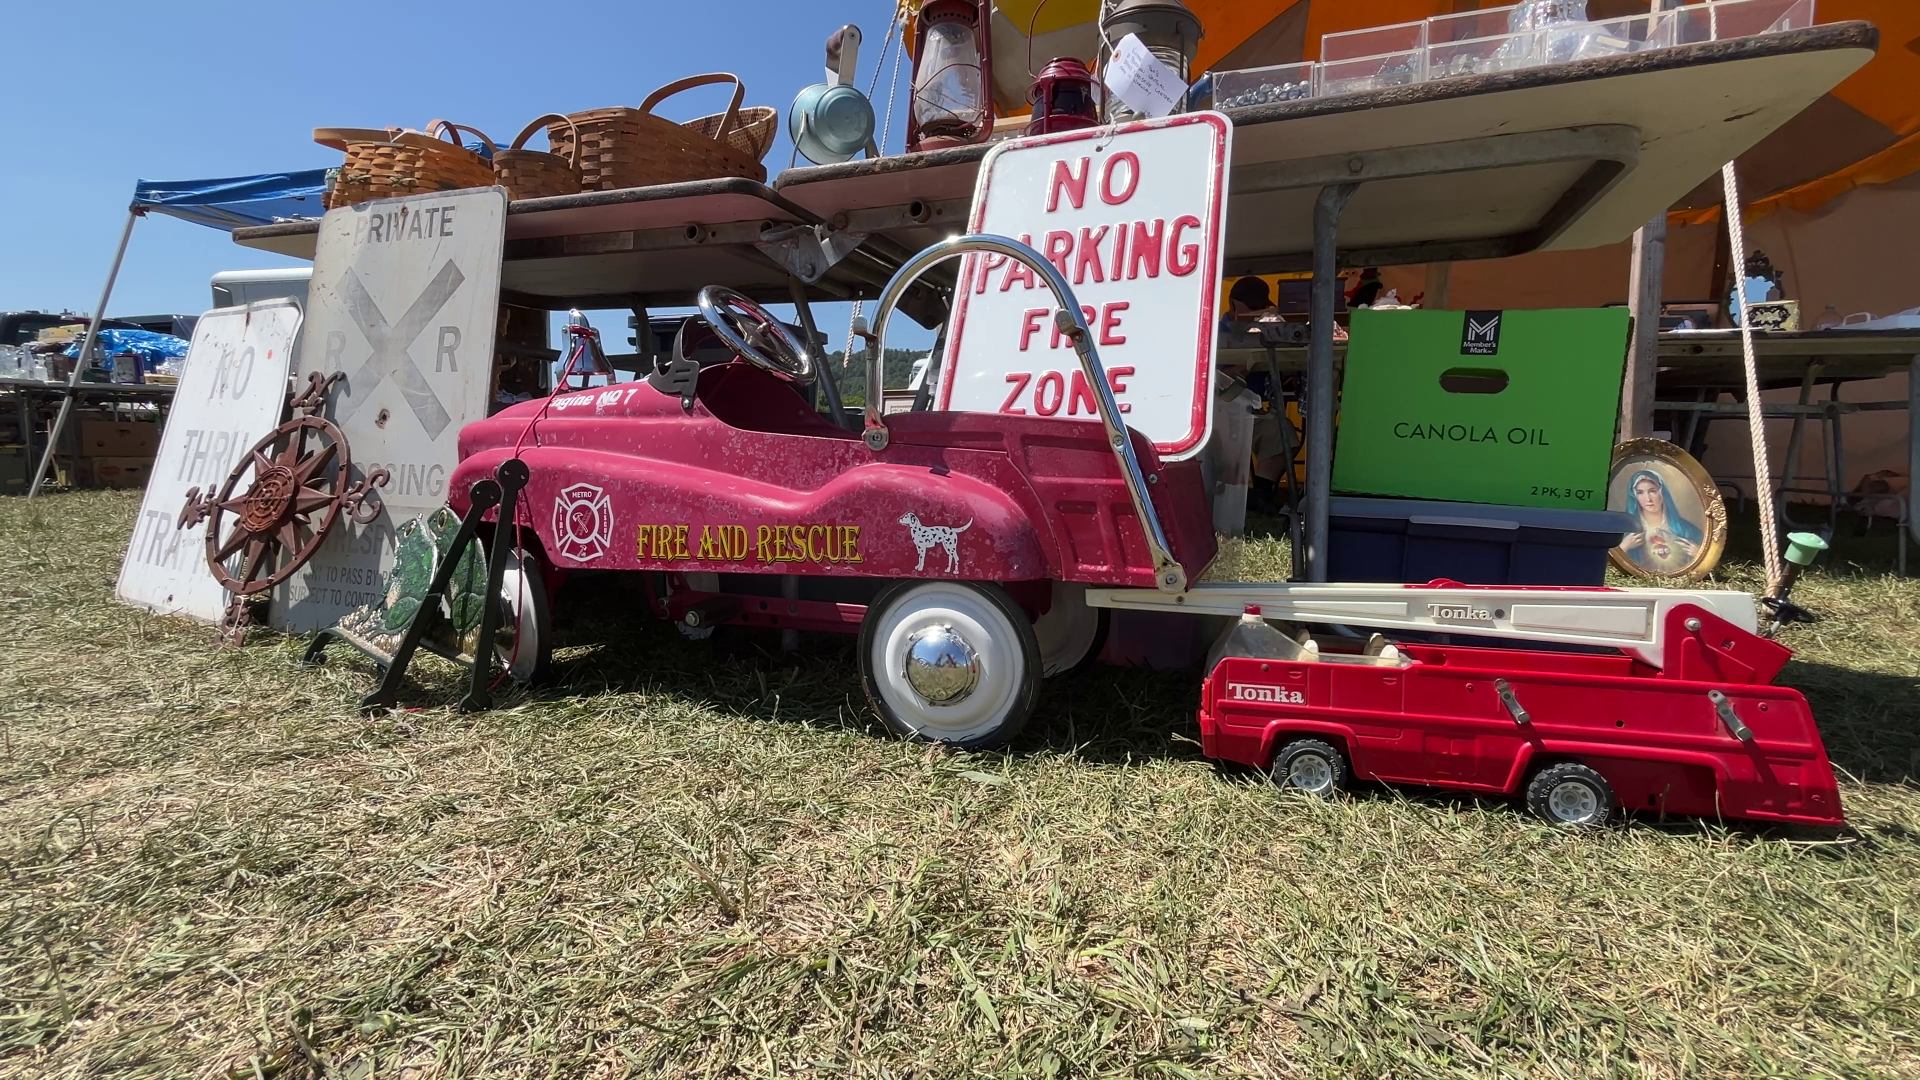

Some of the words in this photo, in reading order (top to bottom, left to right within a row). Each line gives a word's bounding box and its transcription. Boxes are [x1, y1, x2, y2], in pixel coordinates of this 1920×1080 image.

[1044, 151, 1140, 214] NO
[354, 205, 456, 247] PRIVATE
[975, 215, 1201, 295] PARKING
[435, 325, 462, 373] R
[208, 345, 256, 400] NO
[623, 388, 639, 406] 7
[1000, 366, 1136, 416] ZONE
[1394, 422, 1499, 444] CANOLA
[1507, 427, 1550, 446] OIL
[1531, 486, 1538, 496] 2
[1542, 487, 1561, 499] PK,
[1564, 488, 1572, 498] 3
[1575, 490, 1594, 500] QT
[637, 524, 691, 562] FIRE
[696, 525, 748, 561] AND
[756, 525, 864, 565] RESCUE
[326, 566, 338, 583] TO
[340, 566, 364, 586] PASS
[365, 569, 379, 587] BY
[330, 588, 342, 606] TO
[344, 590, 388, 611] CONTRL
[1428, 603, 1493, 621] Tonka
[1228, 682, 1305, 704] Tonka
